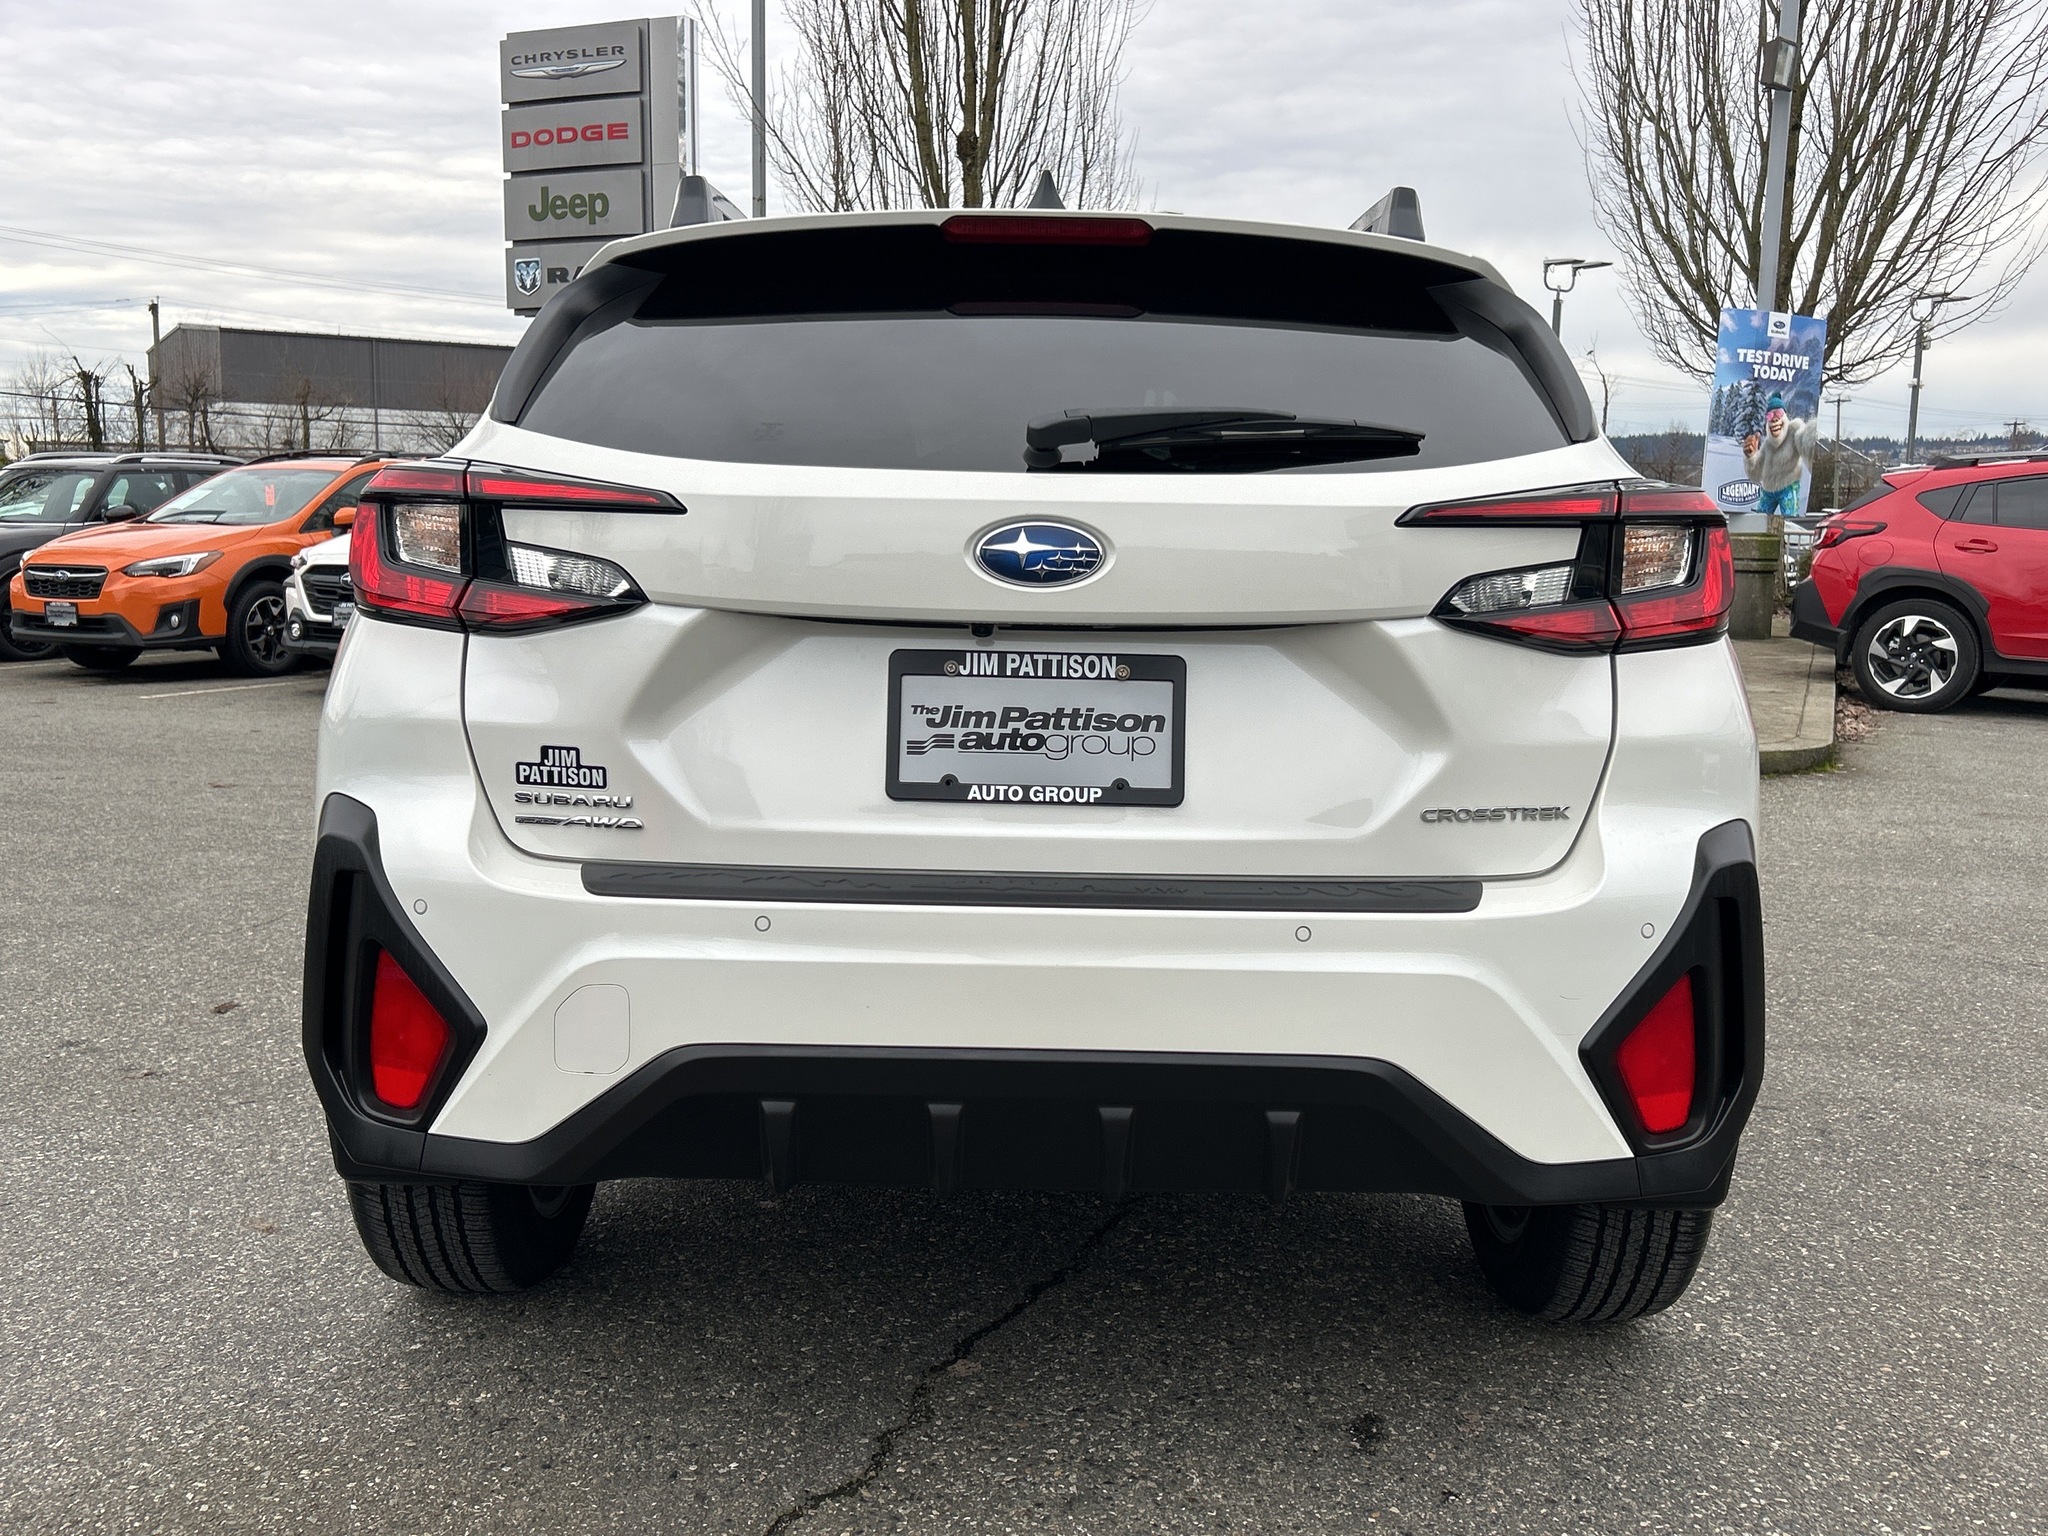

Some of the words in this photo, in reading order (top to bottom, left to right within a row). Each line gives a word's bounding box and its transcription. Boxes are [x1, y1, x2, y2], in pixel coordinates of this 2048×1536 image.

[511, 45, 625, 66] CHRYSLER
[511, 122, 629, 149] DODGE
[528, 186, 609, 225] Jeep
[1737, 348, 1771, 364] TEST
[1772, 353, 1810, 370] DRIVE
[1752, 365, 1796, 382] TODAY
[1722, 483, 1760, 498] LEGENDARY
[959, 653, 998, 676] JIM
[1006, 654, 1118, 679] PATTISON
[911, 704, 940, 715] The
[926, 705, 997, 729] Jim
[998, 706, 1166, 733] Pattison
[544, 749, 577, 767] JIM
[519, 765, 604, 786] PATTISON
[514, 791, 633, 809] SUBARU
[967, 785, 1024, 802] AUTO
[1029, 786, 1103, 803] GROUP
[1420, 804, 1571, 823] CROSSTREK
